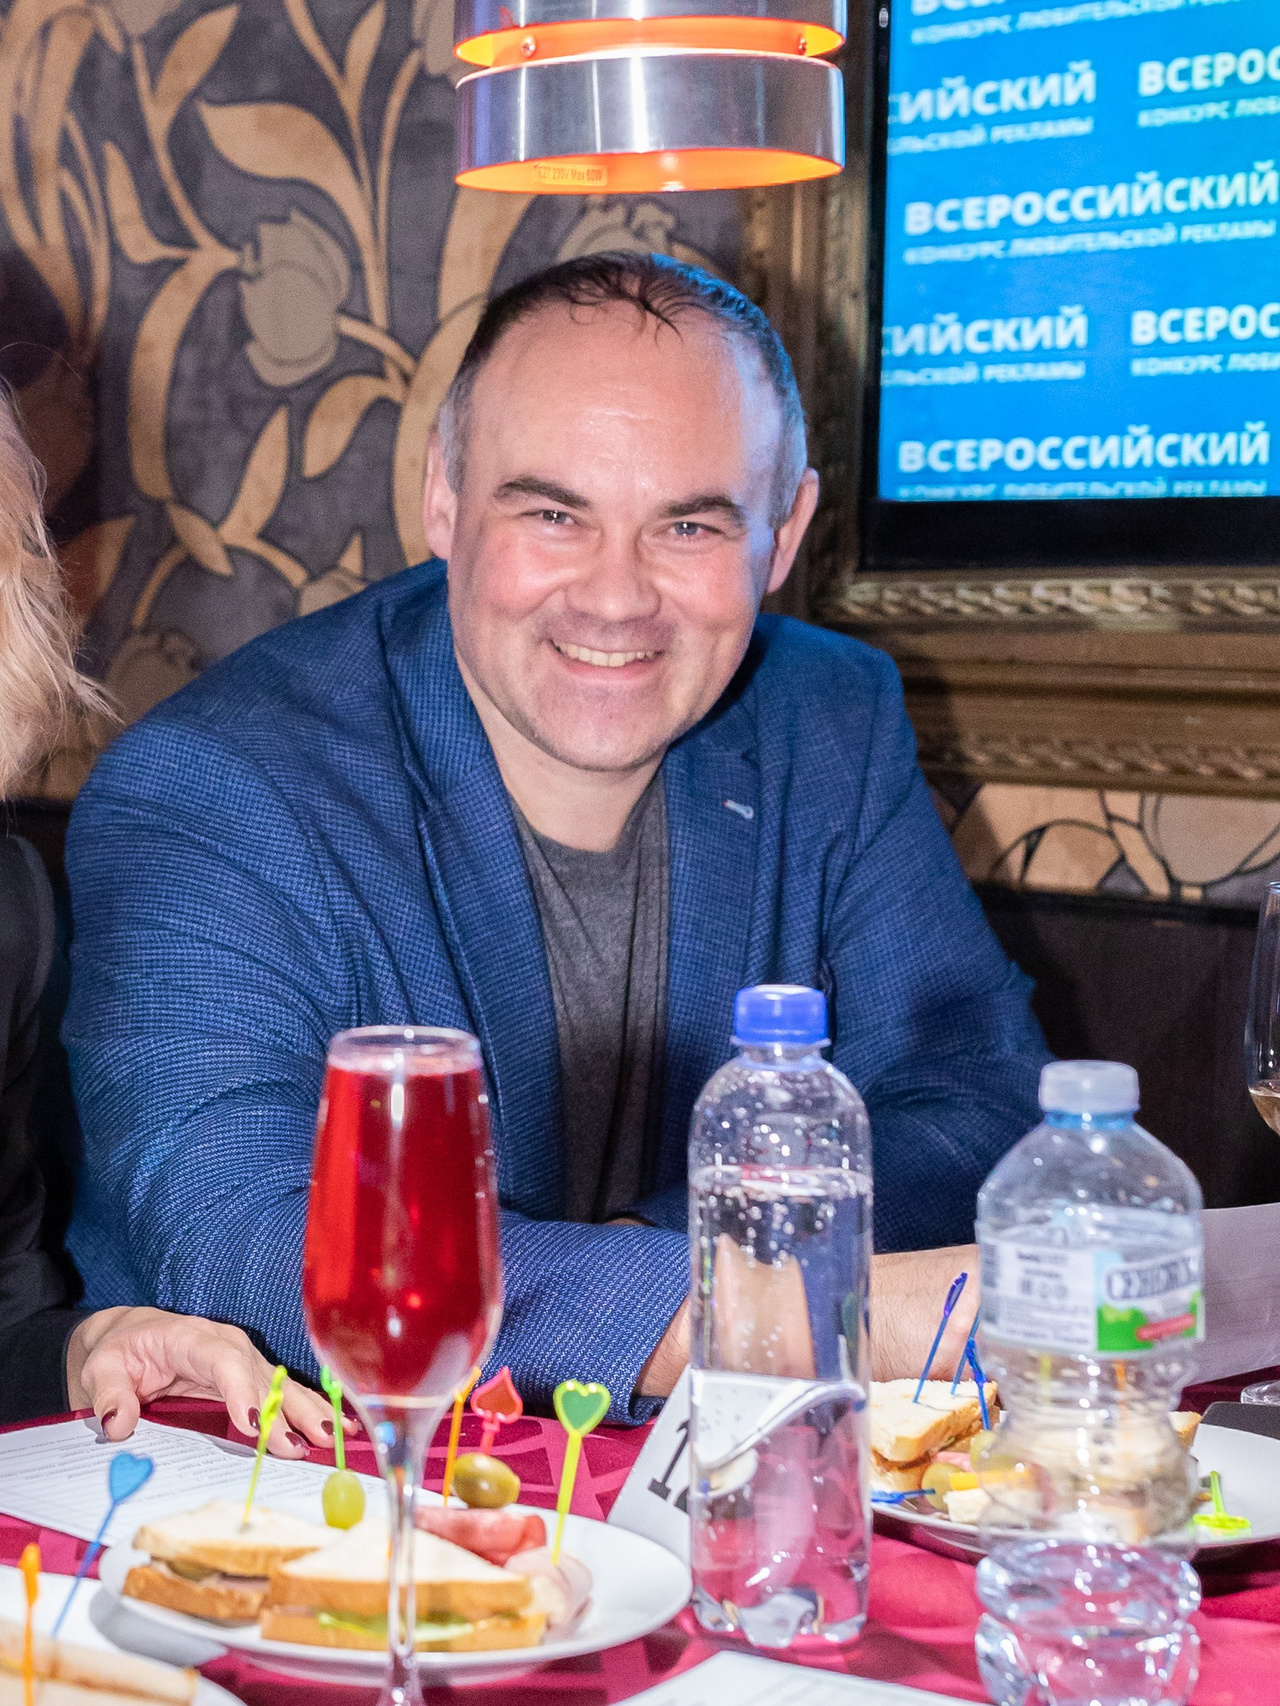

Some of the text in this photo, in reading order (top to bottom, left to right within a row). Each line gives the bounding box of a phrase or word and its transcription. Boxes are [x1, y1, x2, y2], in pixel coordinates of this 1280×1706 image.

[904, 159, 1279, 236] ВСЕРОССИЙСКИЙ
[1131, 302, 1280, 345] ВСЕРОС
[898, 420, 1269, 474] ВСЕРОССИЙСКИЙ
